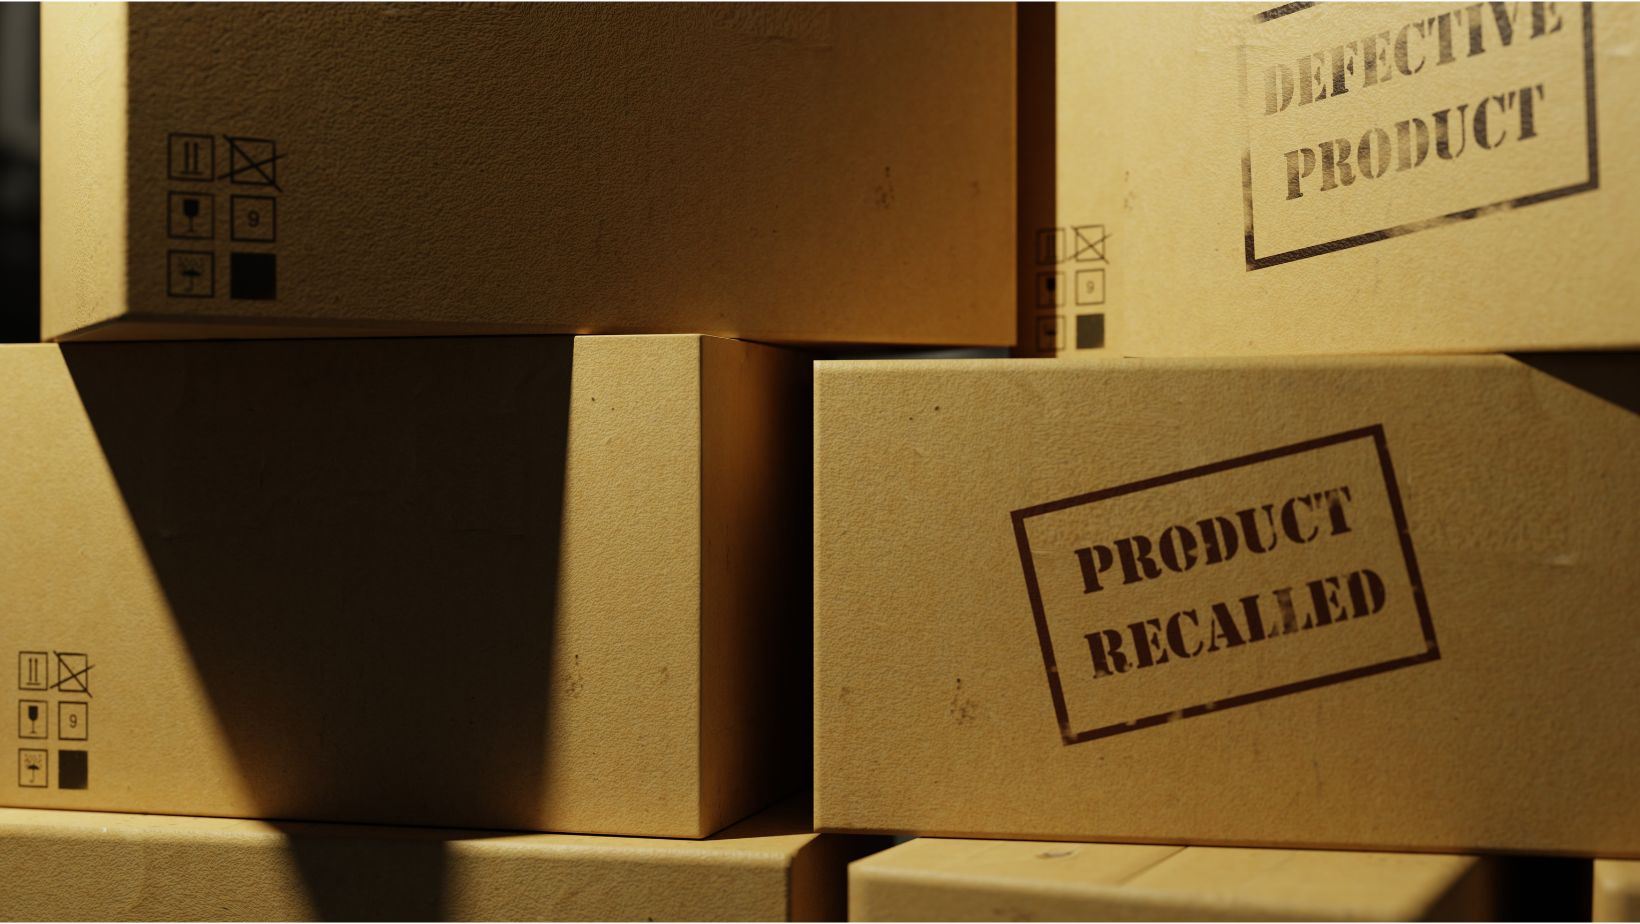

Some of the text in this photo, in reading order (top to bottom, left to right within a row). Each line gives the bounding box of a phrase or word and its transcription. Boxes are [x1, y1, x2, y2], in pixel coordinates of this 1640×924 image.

[1263, 1, 1563, 116] DEFECTIVE
[1284, 84, 1545, 201] PRODUCT
[248, 210, 260, 228] 9
[1074, 486, 1352, 594] PRODUCT
[1084, 568, 1387, 679] RECALLED
[69, 714, 78, 728] 9
